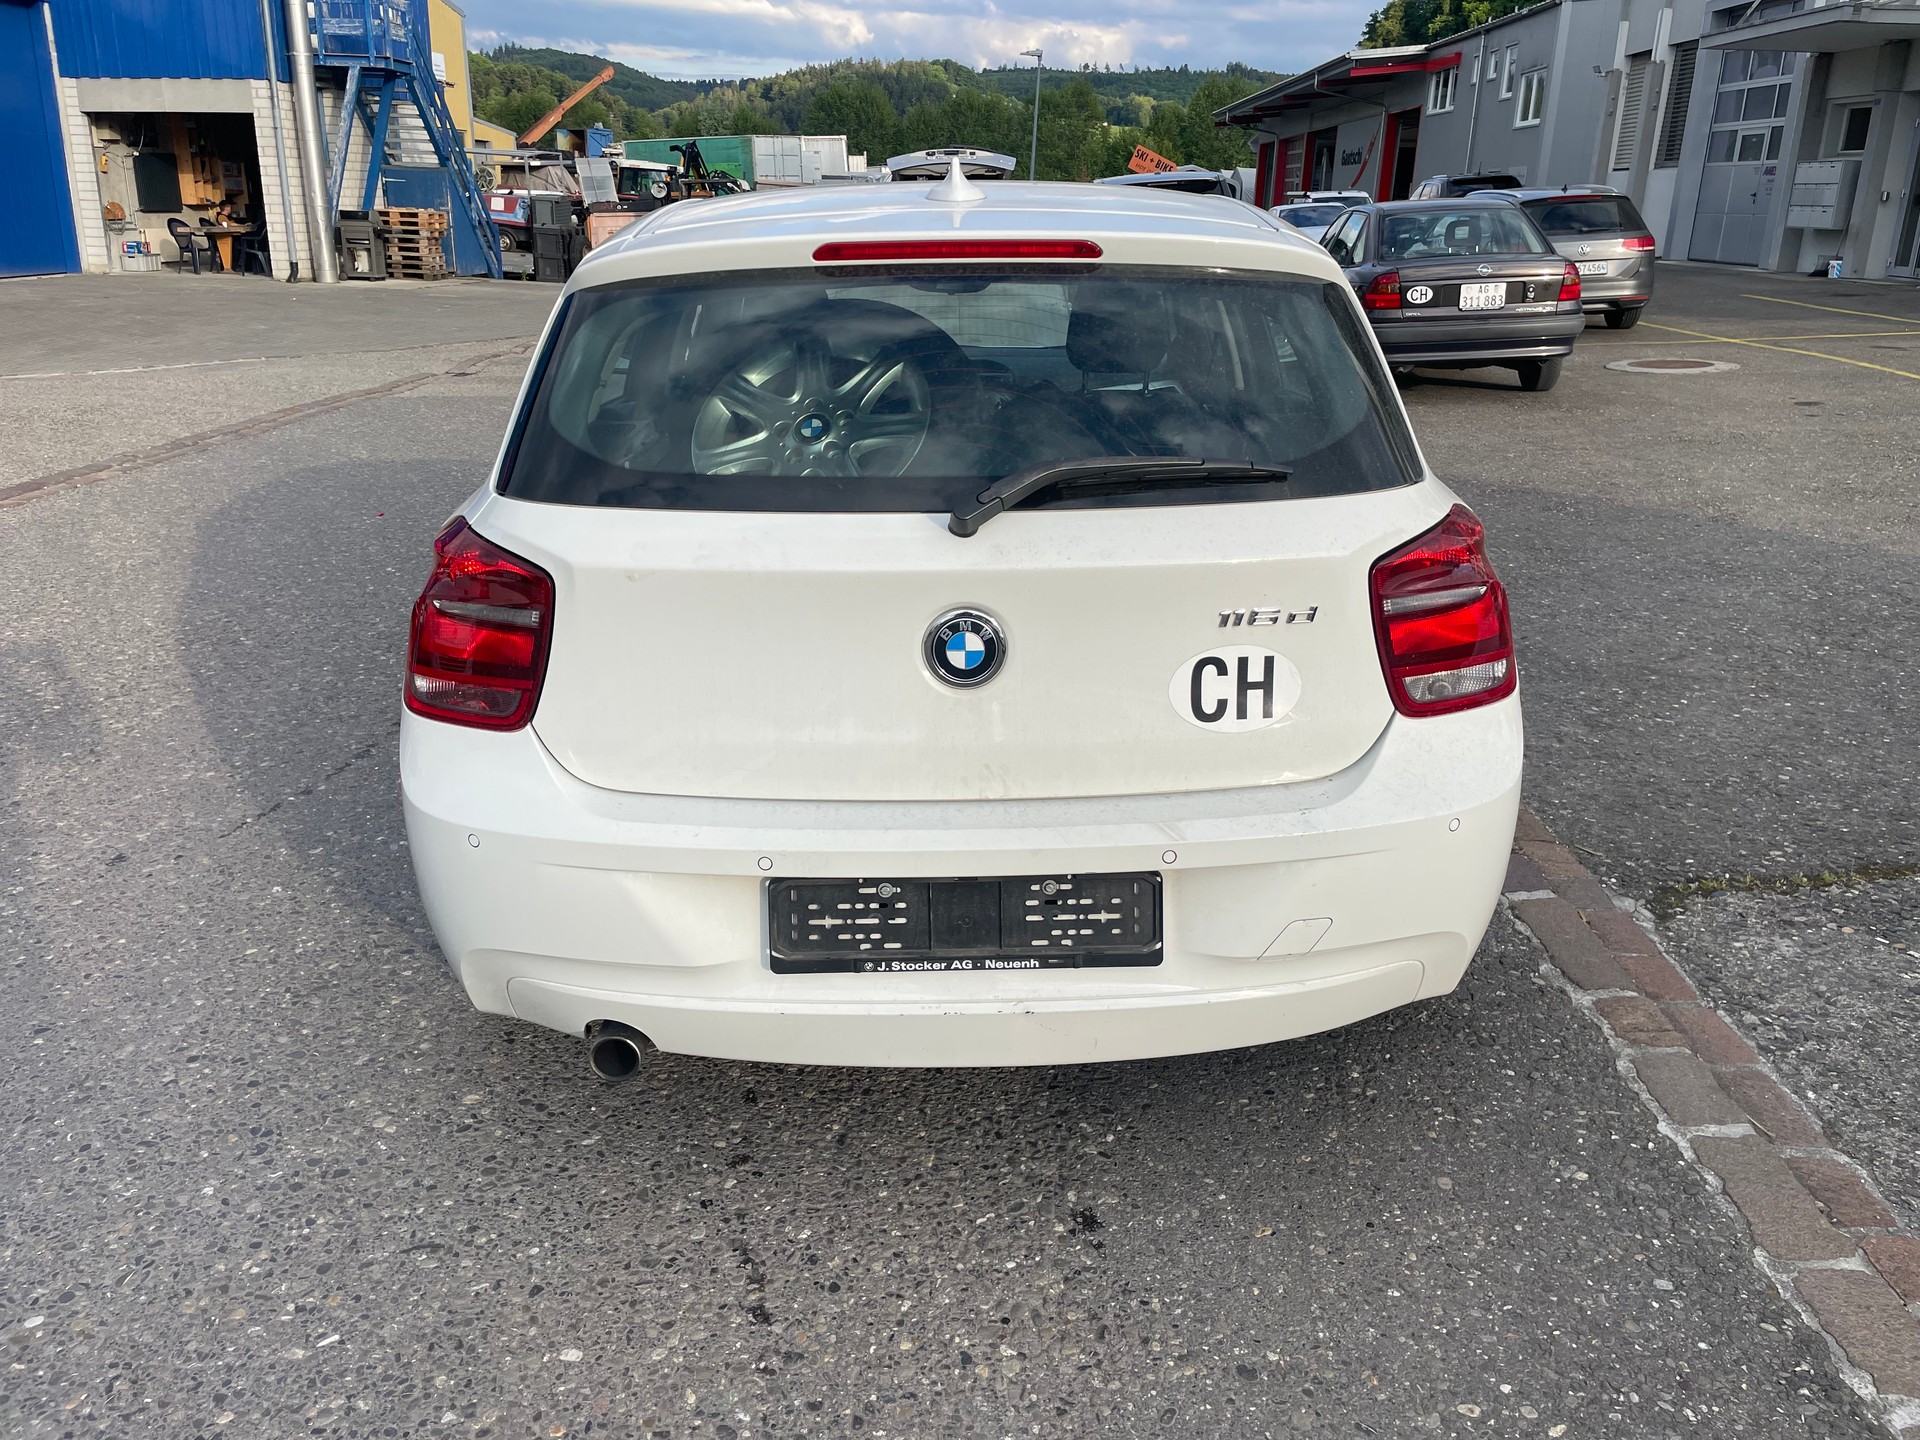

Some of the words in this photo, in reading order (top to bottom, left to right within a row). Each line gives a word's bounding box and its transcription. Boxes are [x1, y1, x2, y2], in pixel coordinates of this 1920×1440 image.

[1135, 149, 1149, 163] SKI
[1155, 159, 1174, 172] BIKE
[1410, 288, 1428, 301] CH
[1478, 284, 1490, 294] AG
[1190, 655, 1275, 723] CH
[891, 960, 947, 971] Stocker
[950, 960, 973, 970] AG
